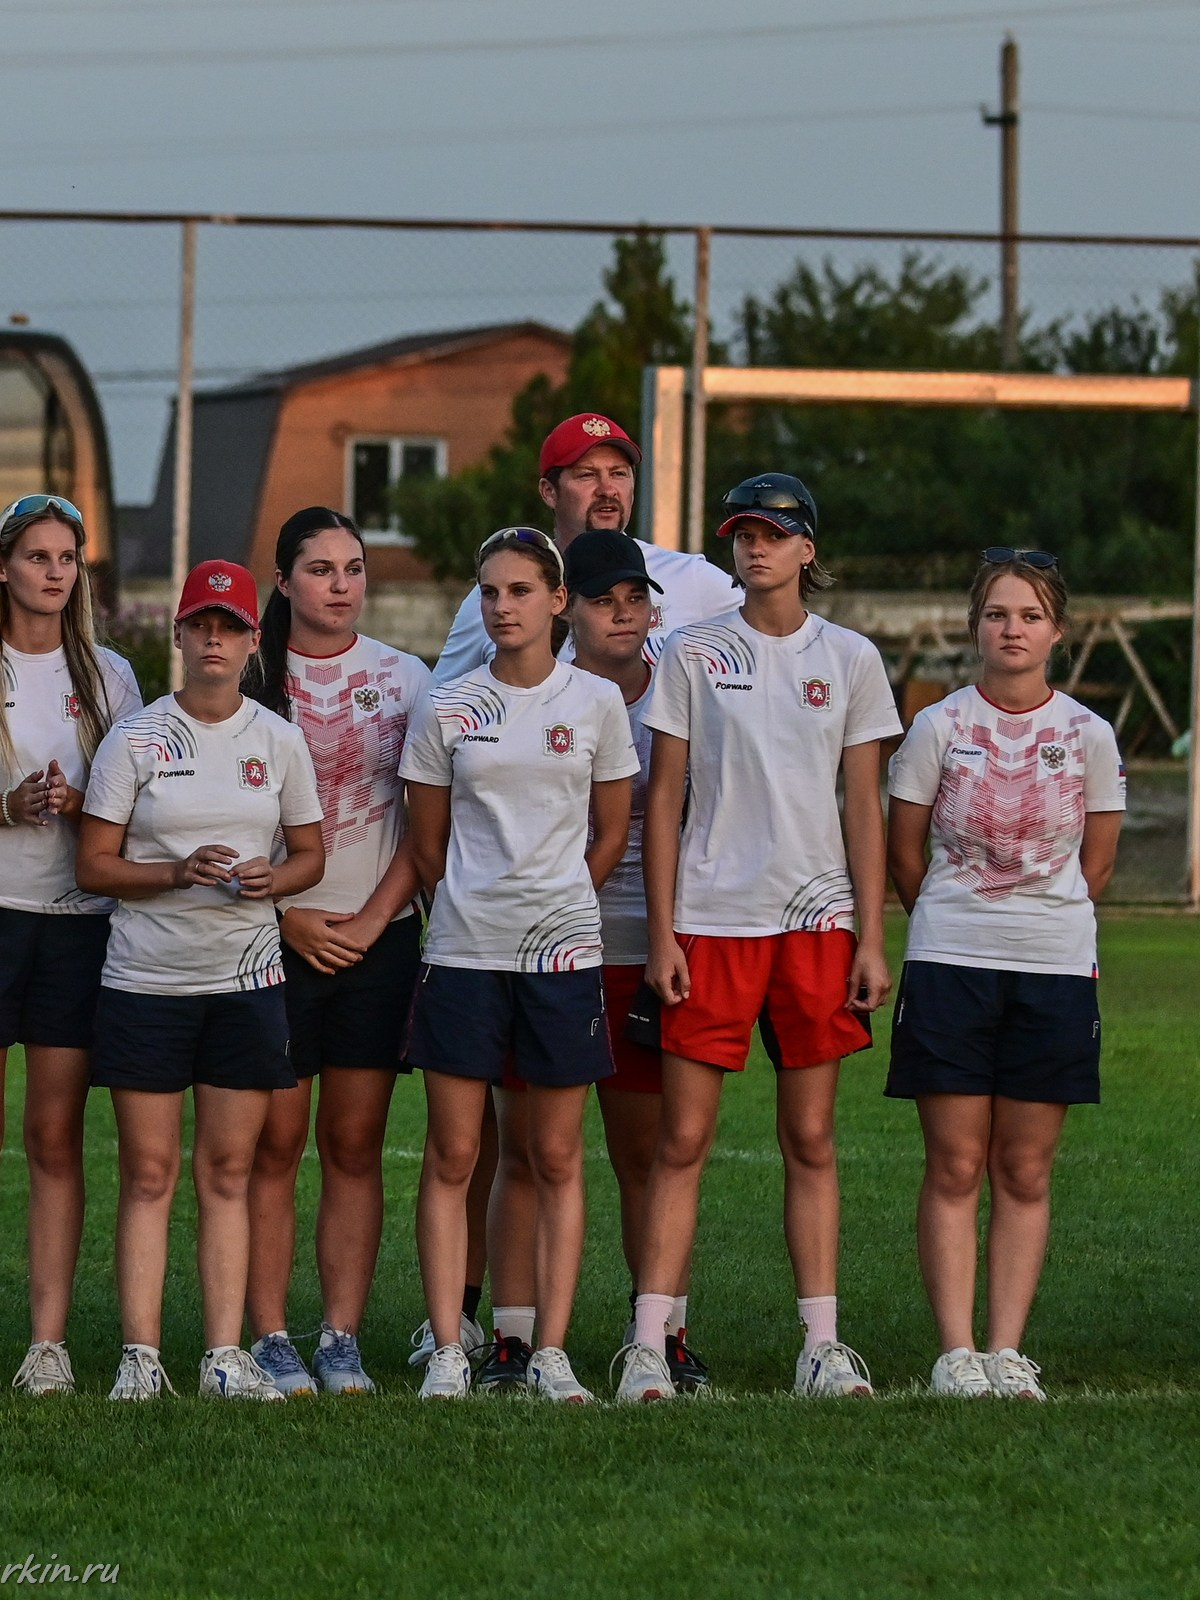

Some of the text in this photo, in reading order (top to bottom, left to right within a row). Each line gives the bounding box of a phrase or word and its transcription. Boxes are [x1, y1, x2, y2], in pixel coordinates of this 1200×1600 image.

[715, 682, 753, 691] FORWARD
[463, 734, 500, 743] FORWARD
[951, 747, 982, 756] FORWARD
[158, 770, 195, 779] FORWARD
